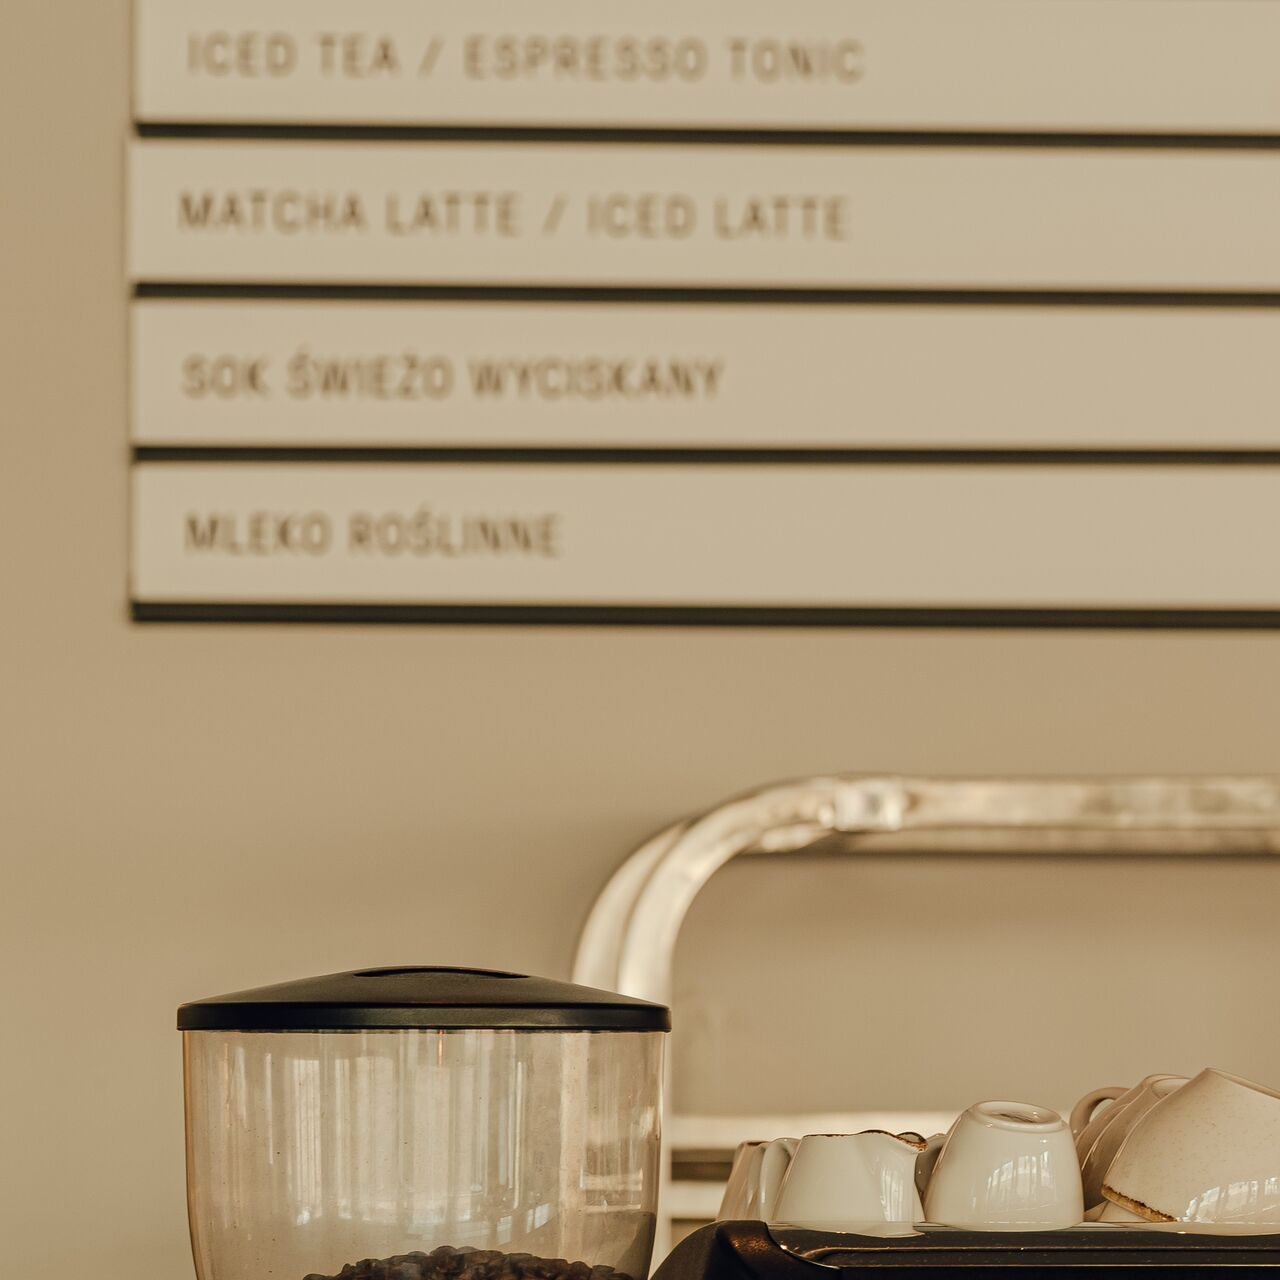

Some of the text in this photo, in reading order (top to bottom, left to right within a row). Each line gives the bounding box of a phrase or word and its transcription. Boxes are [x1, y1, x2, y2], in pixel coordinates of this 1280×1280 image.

[186, 30, 302, 81] ICED
[317, 31, 402, 82] TEA
[463, 33, 710, 84] ESPRESSO
[728, 36, 867, 87] TONIC
[177, 188, 370, 238] MATCHA
[384, 190, 523, 240] LATTE
[587, 193, 700, 241] ICED
[714, 195, 851, 244] LATTE
[182, 354, 270, 402] SOK
[467, 357, 726, 404] WYCISKANY
[183, 510, 335, 559] MLEKO
